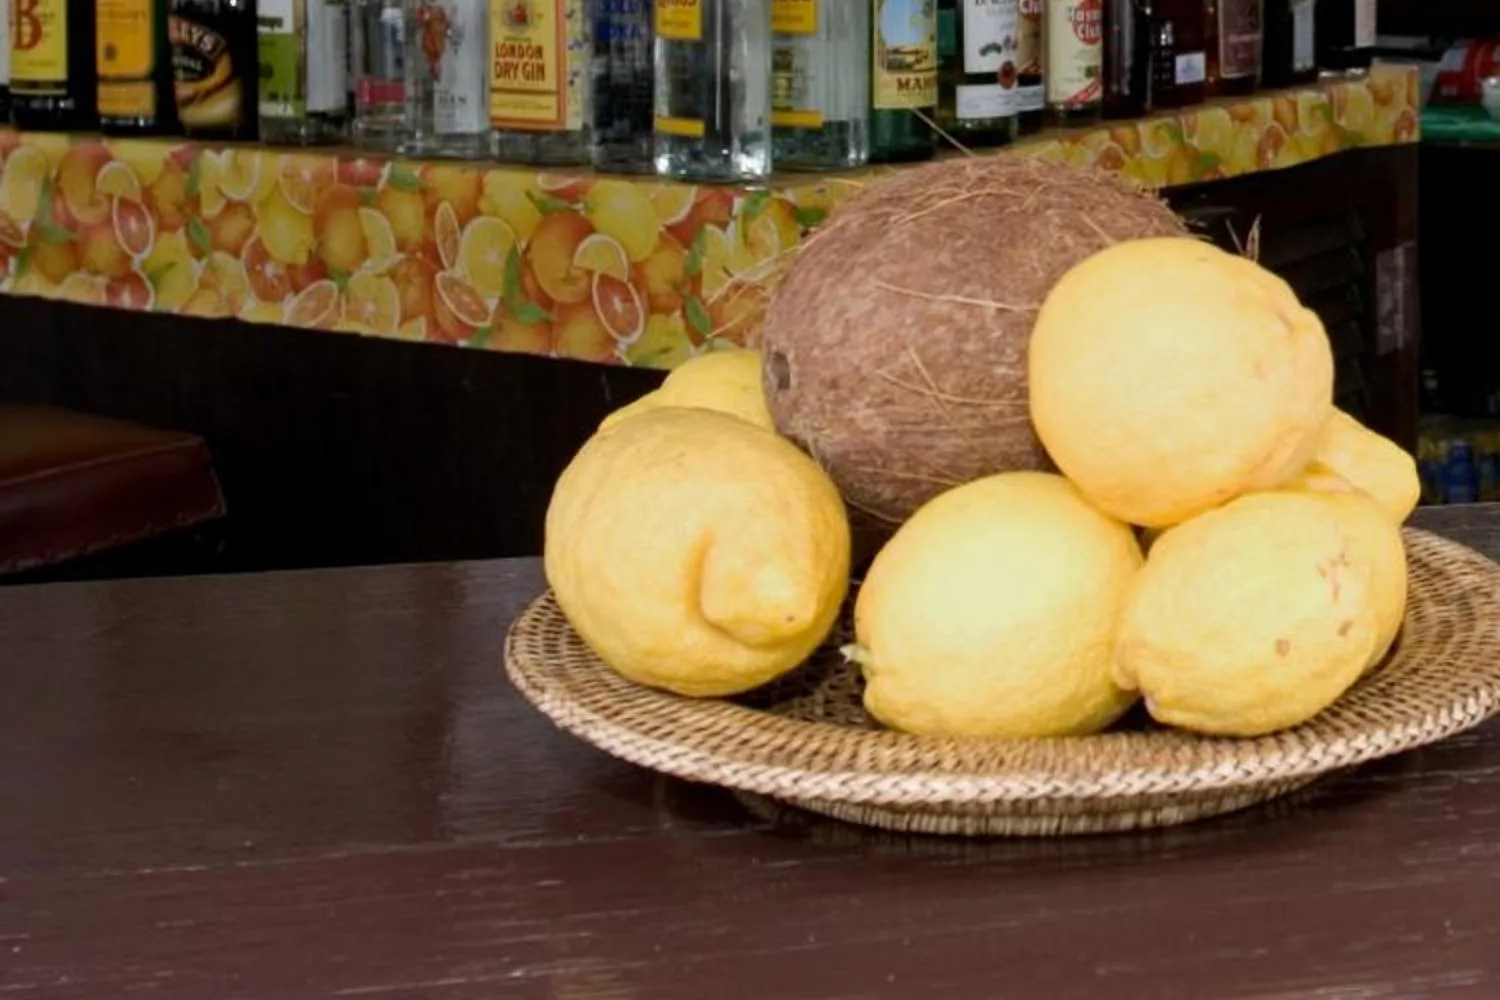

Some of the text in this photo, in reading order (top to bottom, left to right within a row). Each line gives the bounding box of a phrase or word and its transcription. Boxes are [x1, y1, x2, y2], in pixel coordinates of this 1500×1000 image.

[495, 42, 543, 60] LONDON
[494, 61, 545, 82] DRY GIN
